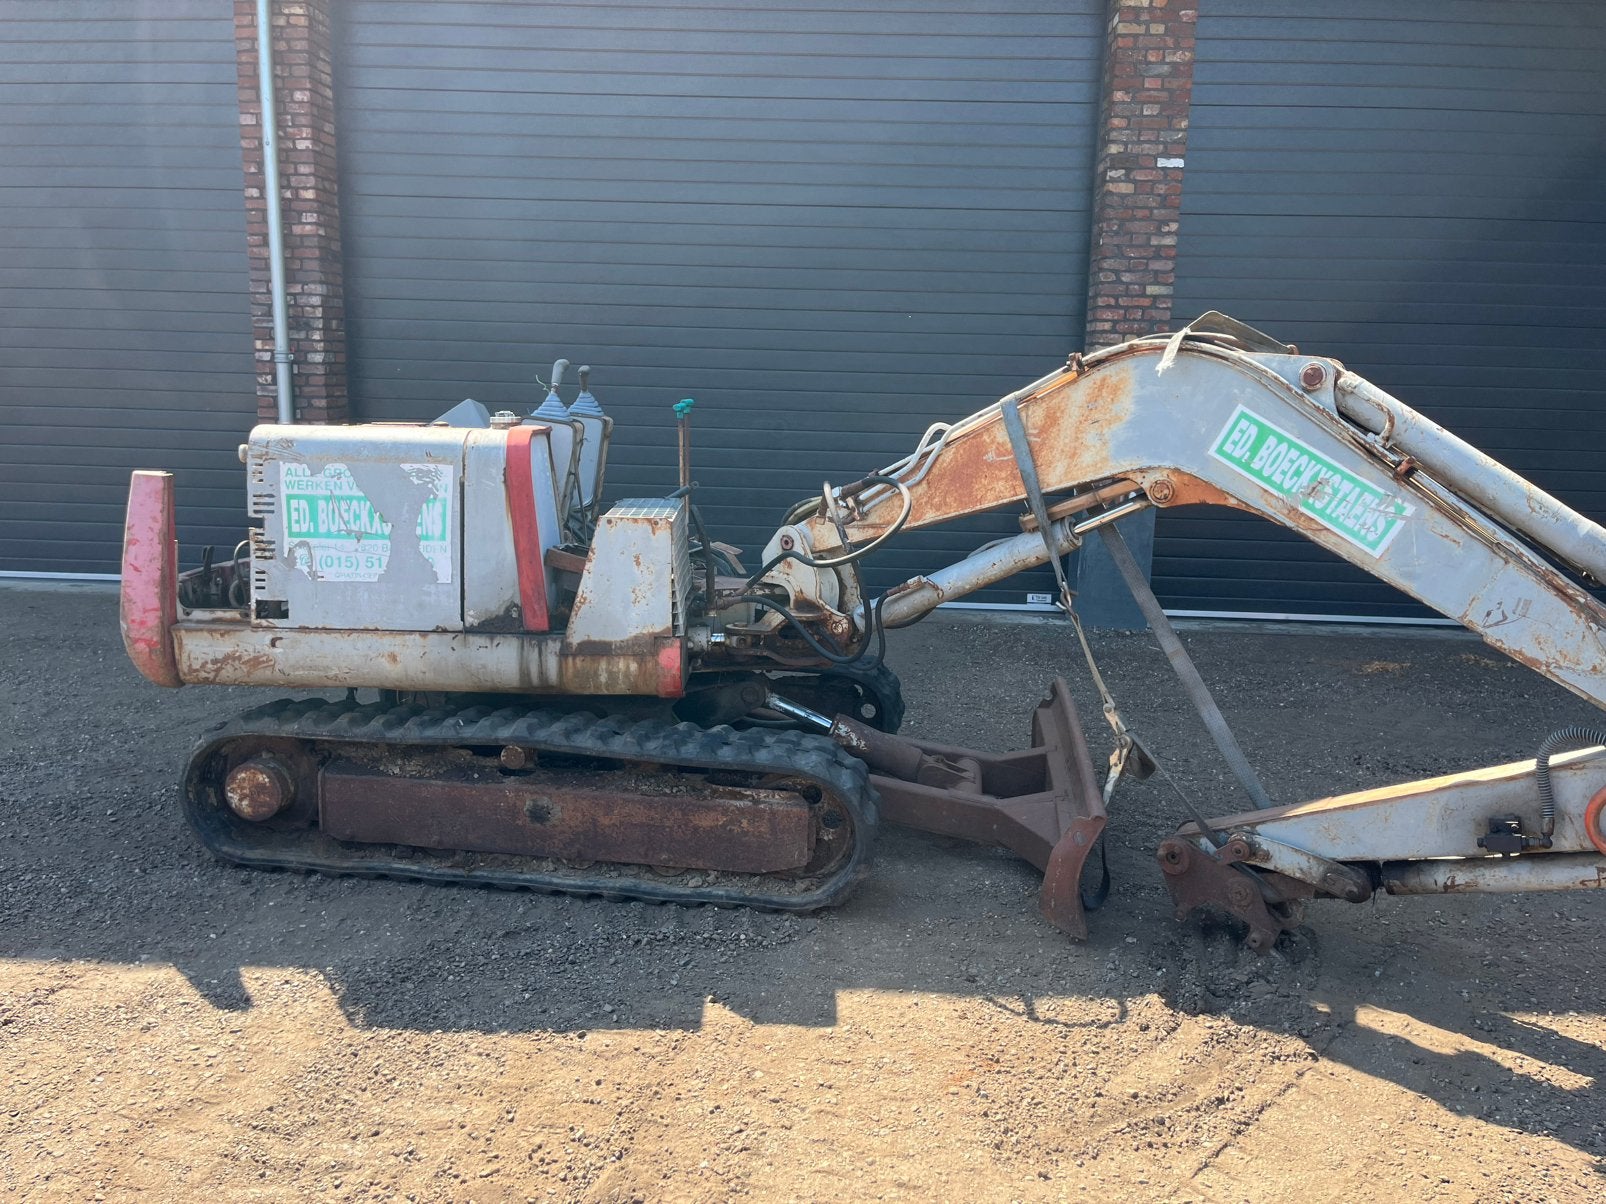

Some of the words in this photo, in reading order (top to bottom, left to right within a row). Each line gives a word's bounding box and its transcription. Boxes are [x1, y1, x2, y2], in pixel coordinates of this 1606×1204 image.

[1222, 417, 1258, 463] ED.
[284, 479, 343, 491] WERKEN
[290, 499, 314, 533] ED.
[319, 555, 359, 571] (015)
